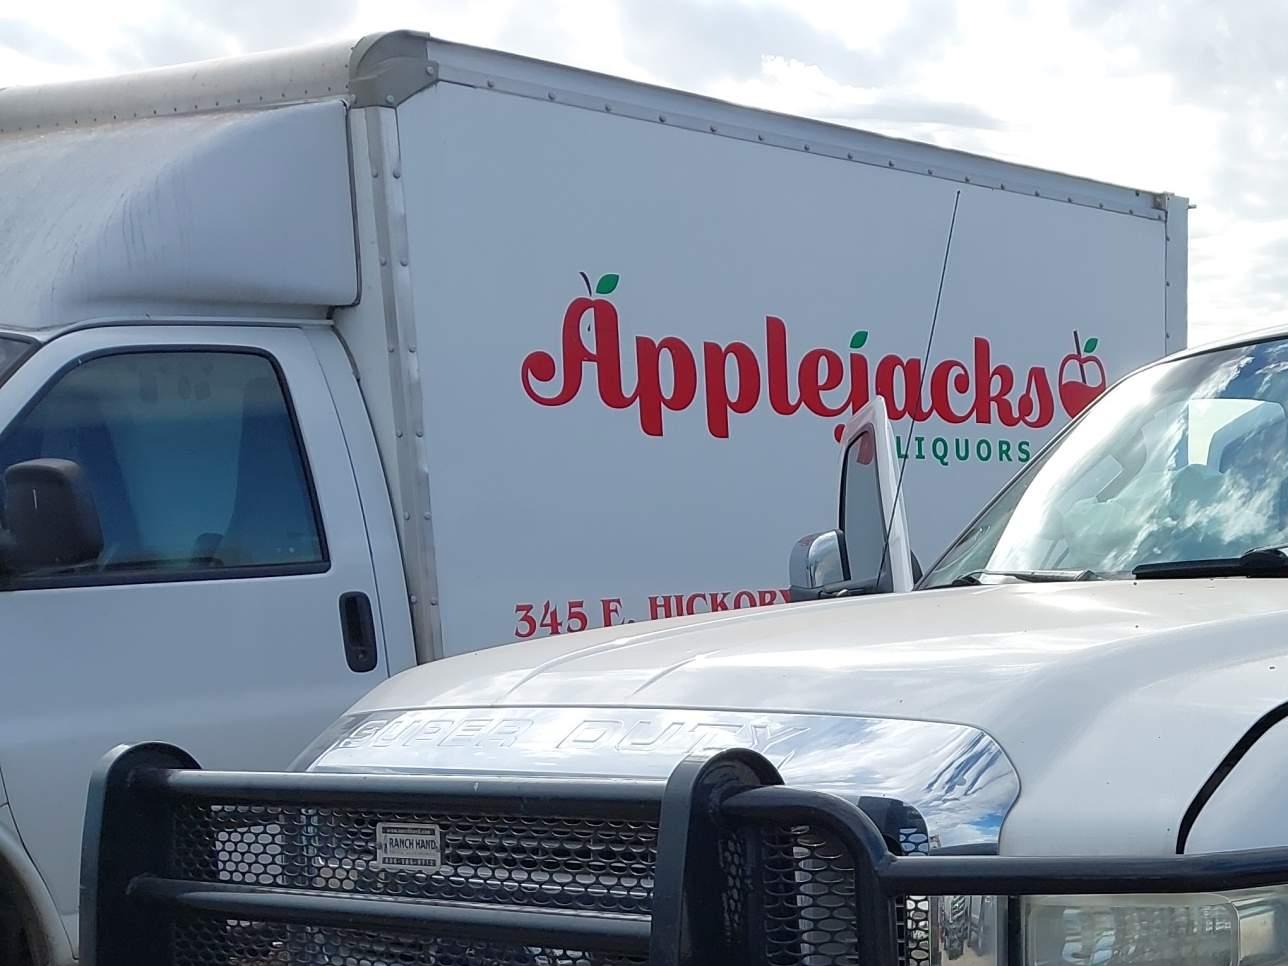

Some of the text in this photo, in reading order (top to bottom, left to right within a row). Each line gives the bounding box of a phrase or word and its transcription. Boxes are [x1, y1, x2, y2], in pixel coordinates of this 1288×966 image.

[521, 296, 1055, 443] Applejacks
[896, 436, 1031, 466] LIQUORS
[514, 600, 588, 638] 345
[339, 718, 534, 749] SUPER
[389, 838, 436, 850] RANCH HAND
